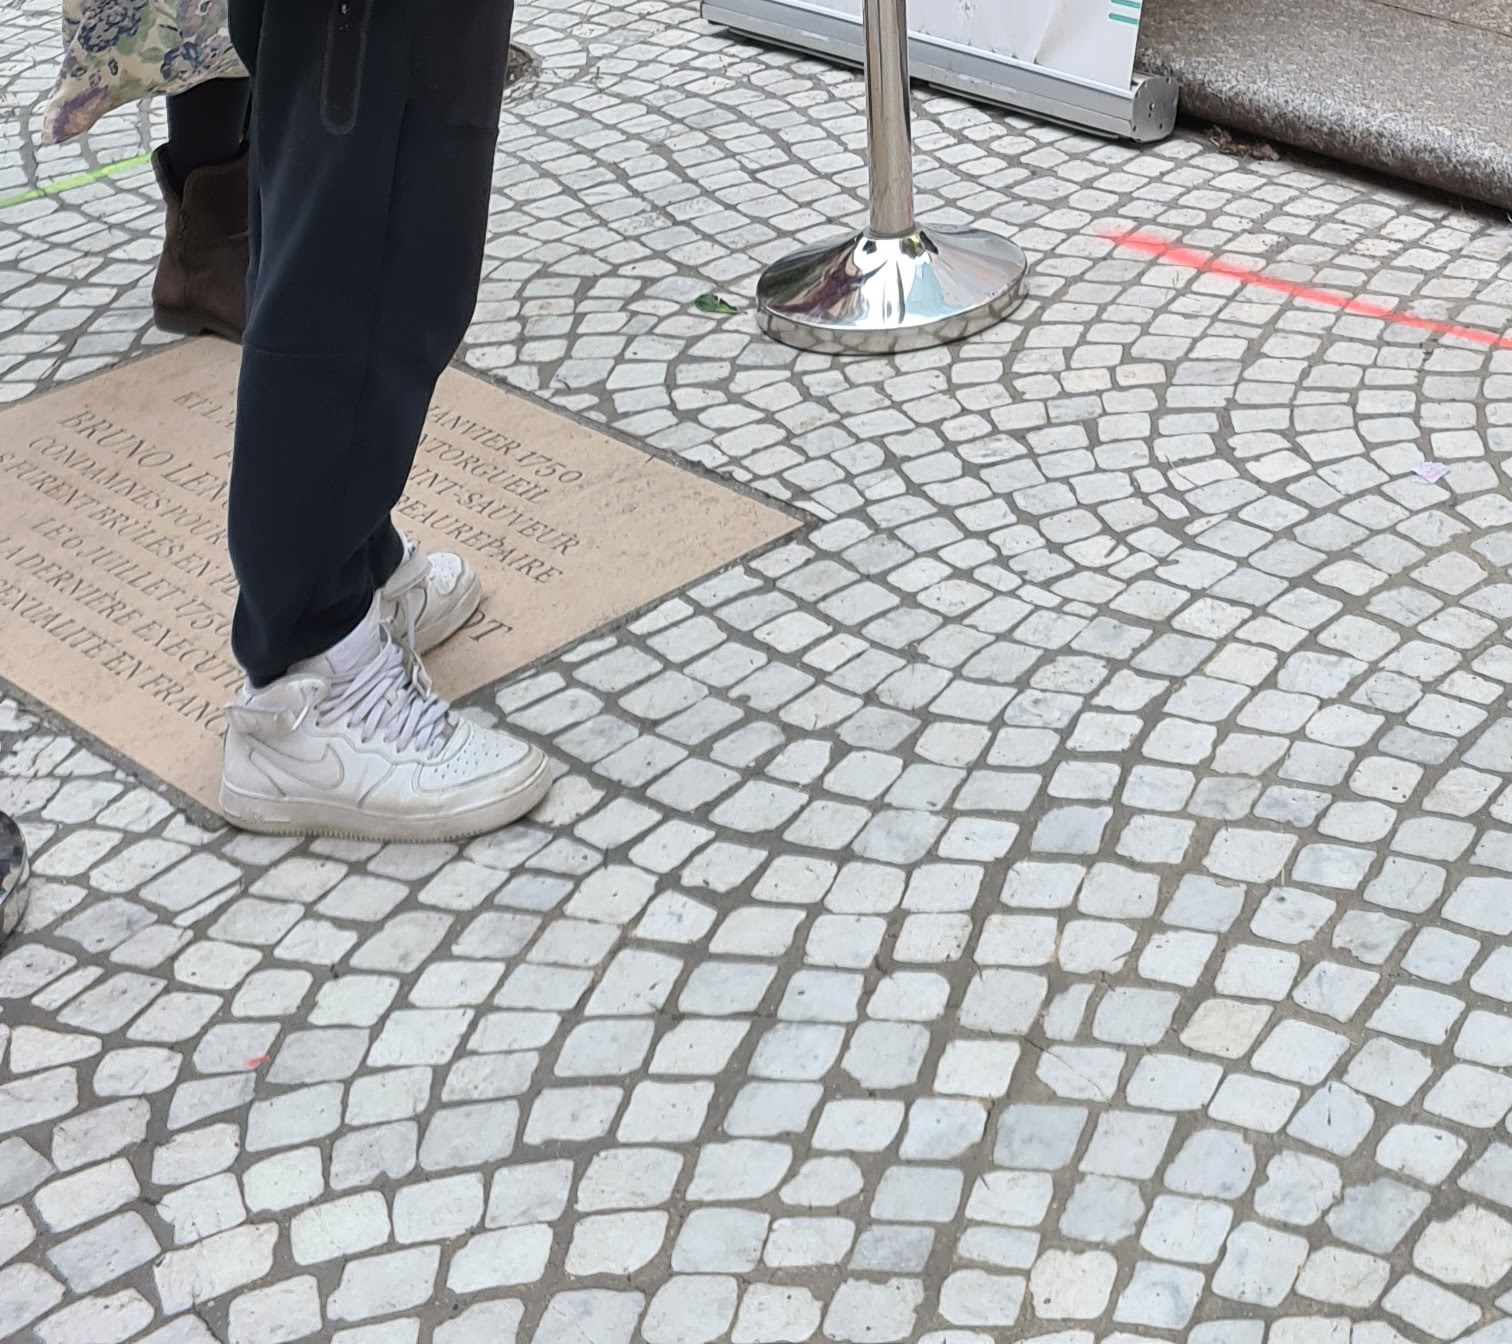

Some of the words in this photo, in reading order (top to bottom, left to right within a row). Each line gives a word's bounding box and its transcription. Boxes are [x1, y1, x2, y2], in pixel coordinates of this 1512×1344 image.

[28, 437, 171, 511] CONDAMNÉS
[58, 410, 174, 468] BRUNO
[418, 433, 550, 505] NTORGUEIL
[428, 405, 521, 457] ANVIER
[516, 450, 582, 484] 1750
[31, 518, 72, 540] LE
[410, 464, 581, 556] INT-SAUVEUR
[0, 579, 122, 659] EXUALITÉ
[101, 651, 152, 680] EN
[138, 673, 228, 736] FRANC
